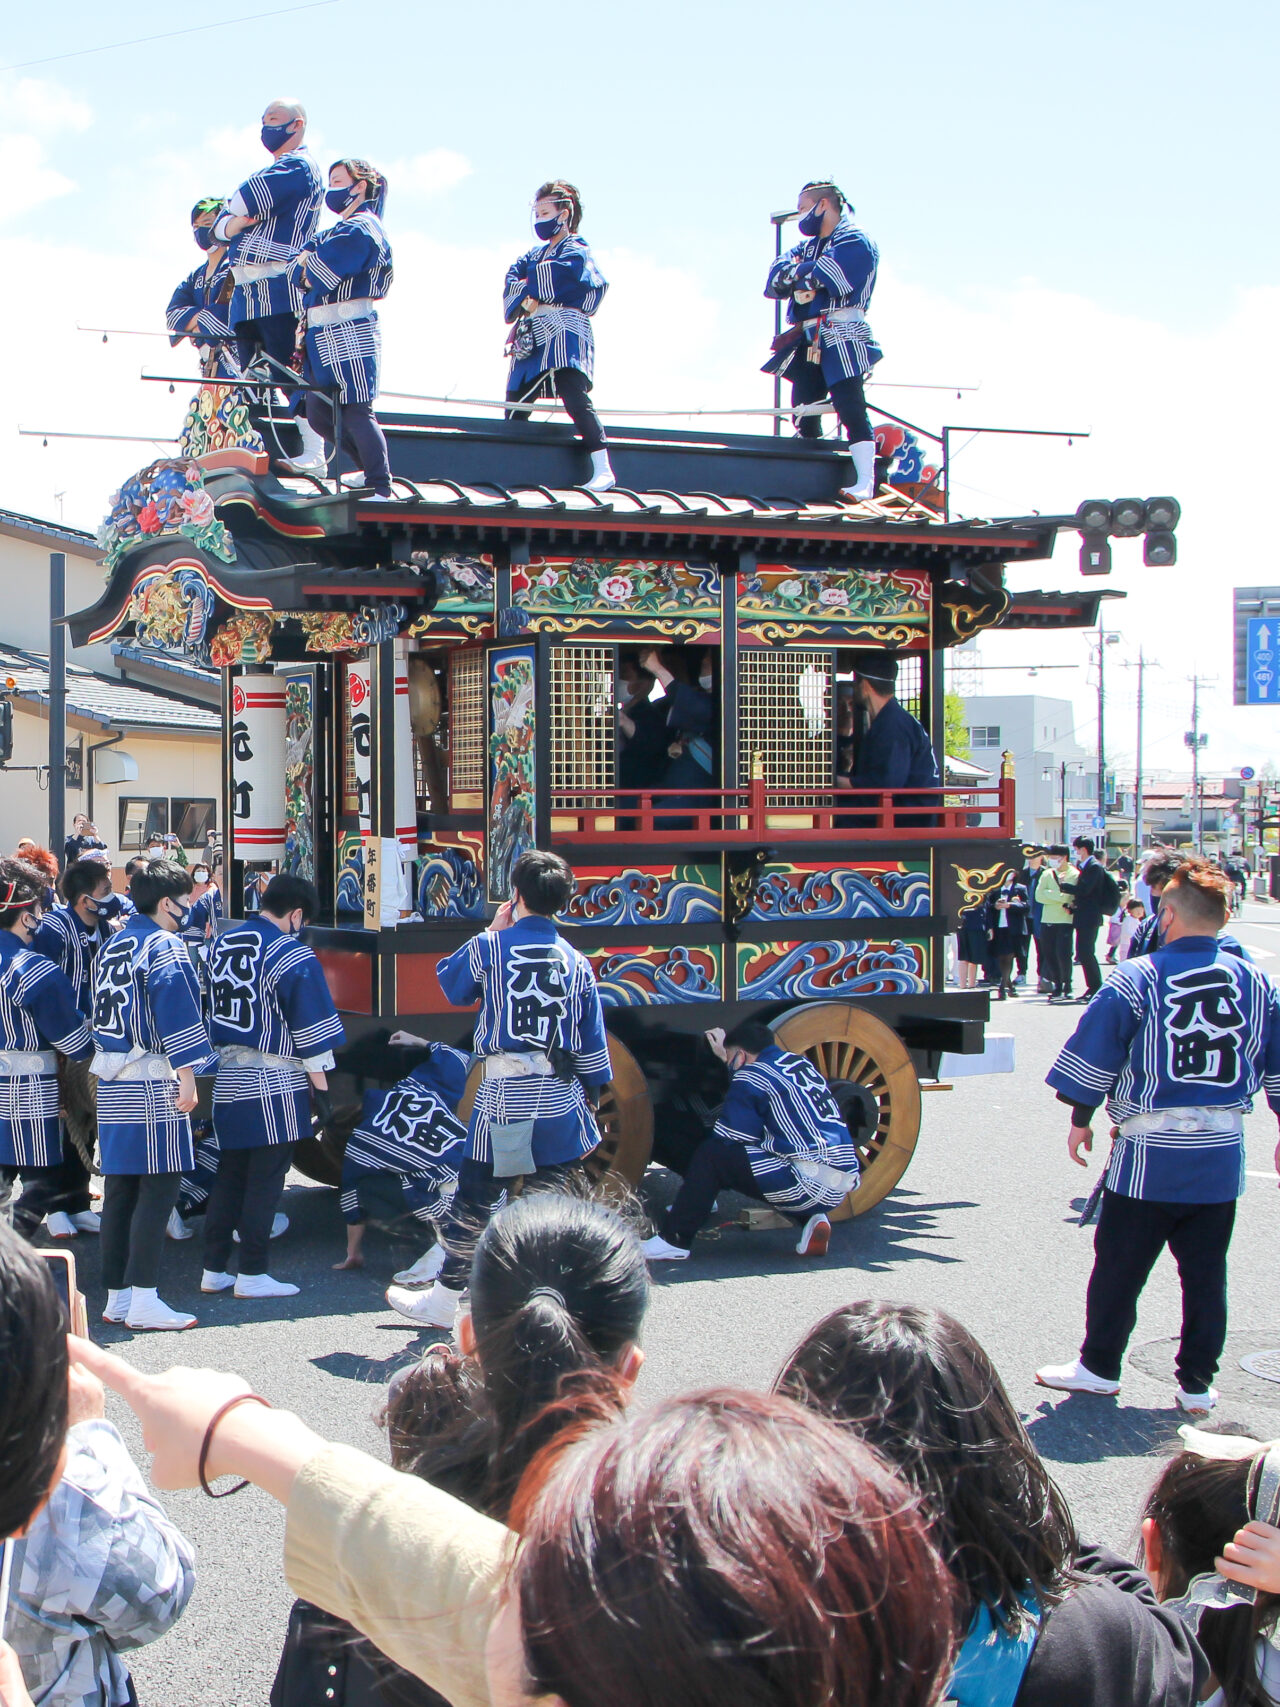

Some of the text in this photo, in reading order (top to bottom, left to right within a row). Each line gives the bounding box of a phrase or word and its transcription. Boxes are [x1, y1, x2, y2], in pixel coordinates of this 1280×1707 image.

[366, 847, 378, 918] 年番町
[94, 936, 138, 1039] 元町
[212, 930, 262, 1032] 元町
[507, 944, 570, 1048] 元町
[1164, 963, 1247, 1088] 元町
[372, 1090, 468, 1157] 元町
[774, 1051, 847, 1127] 元町
